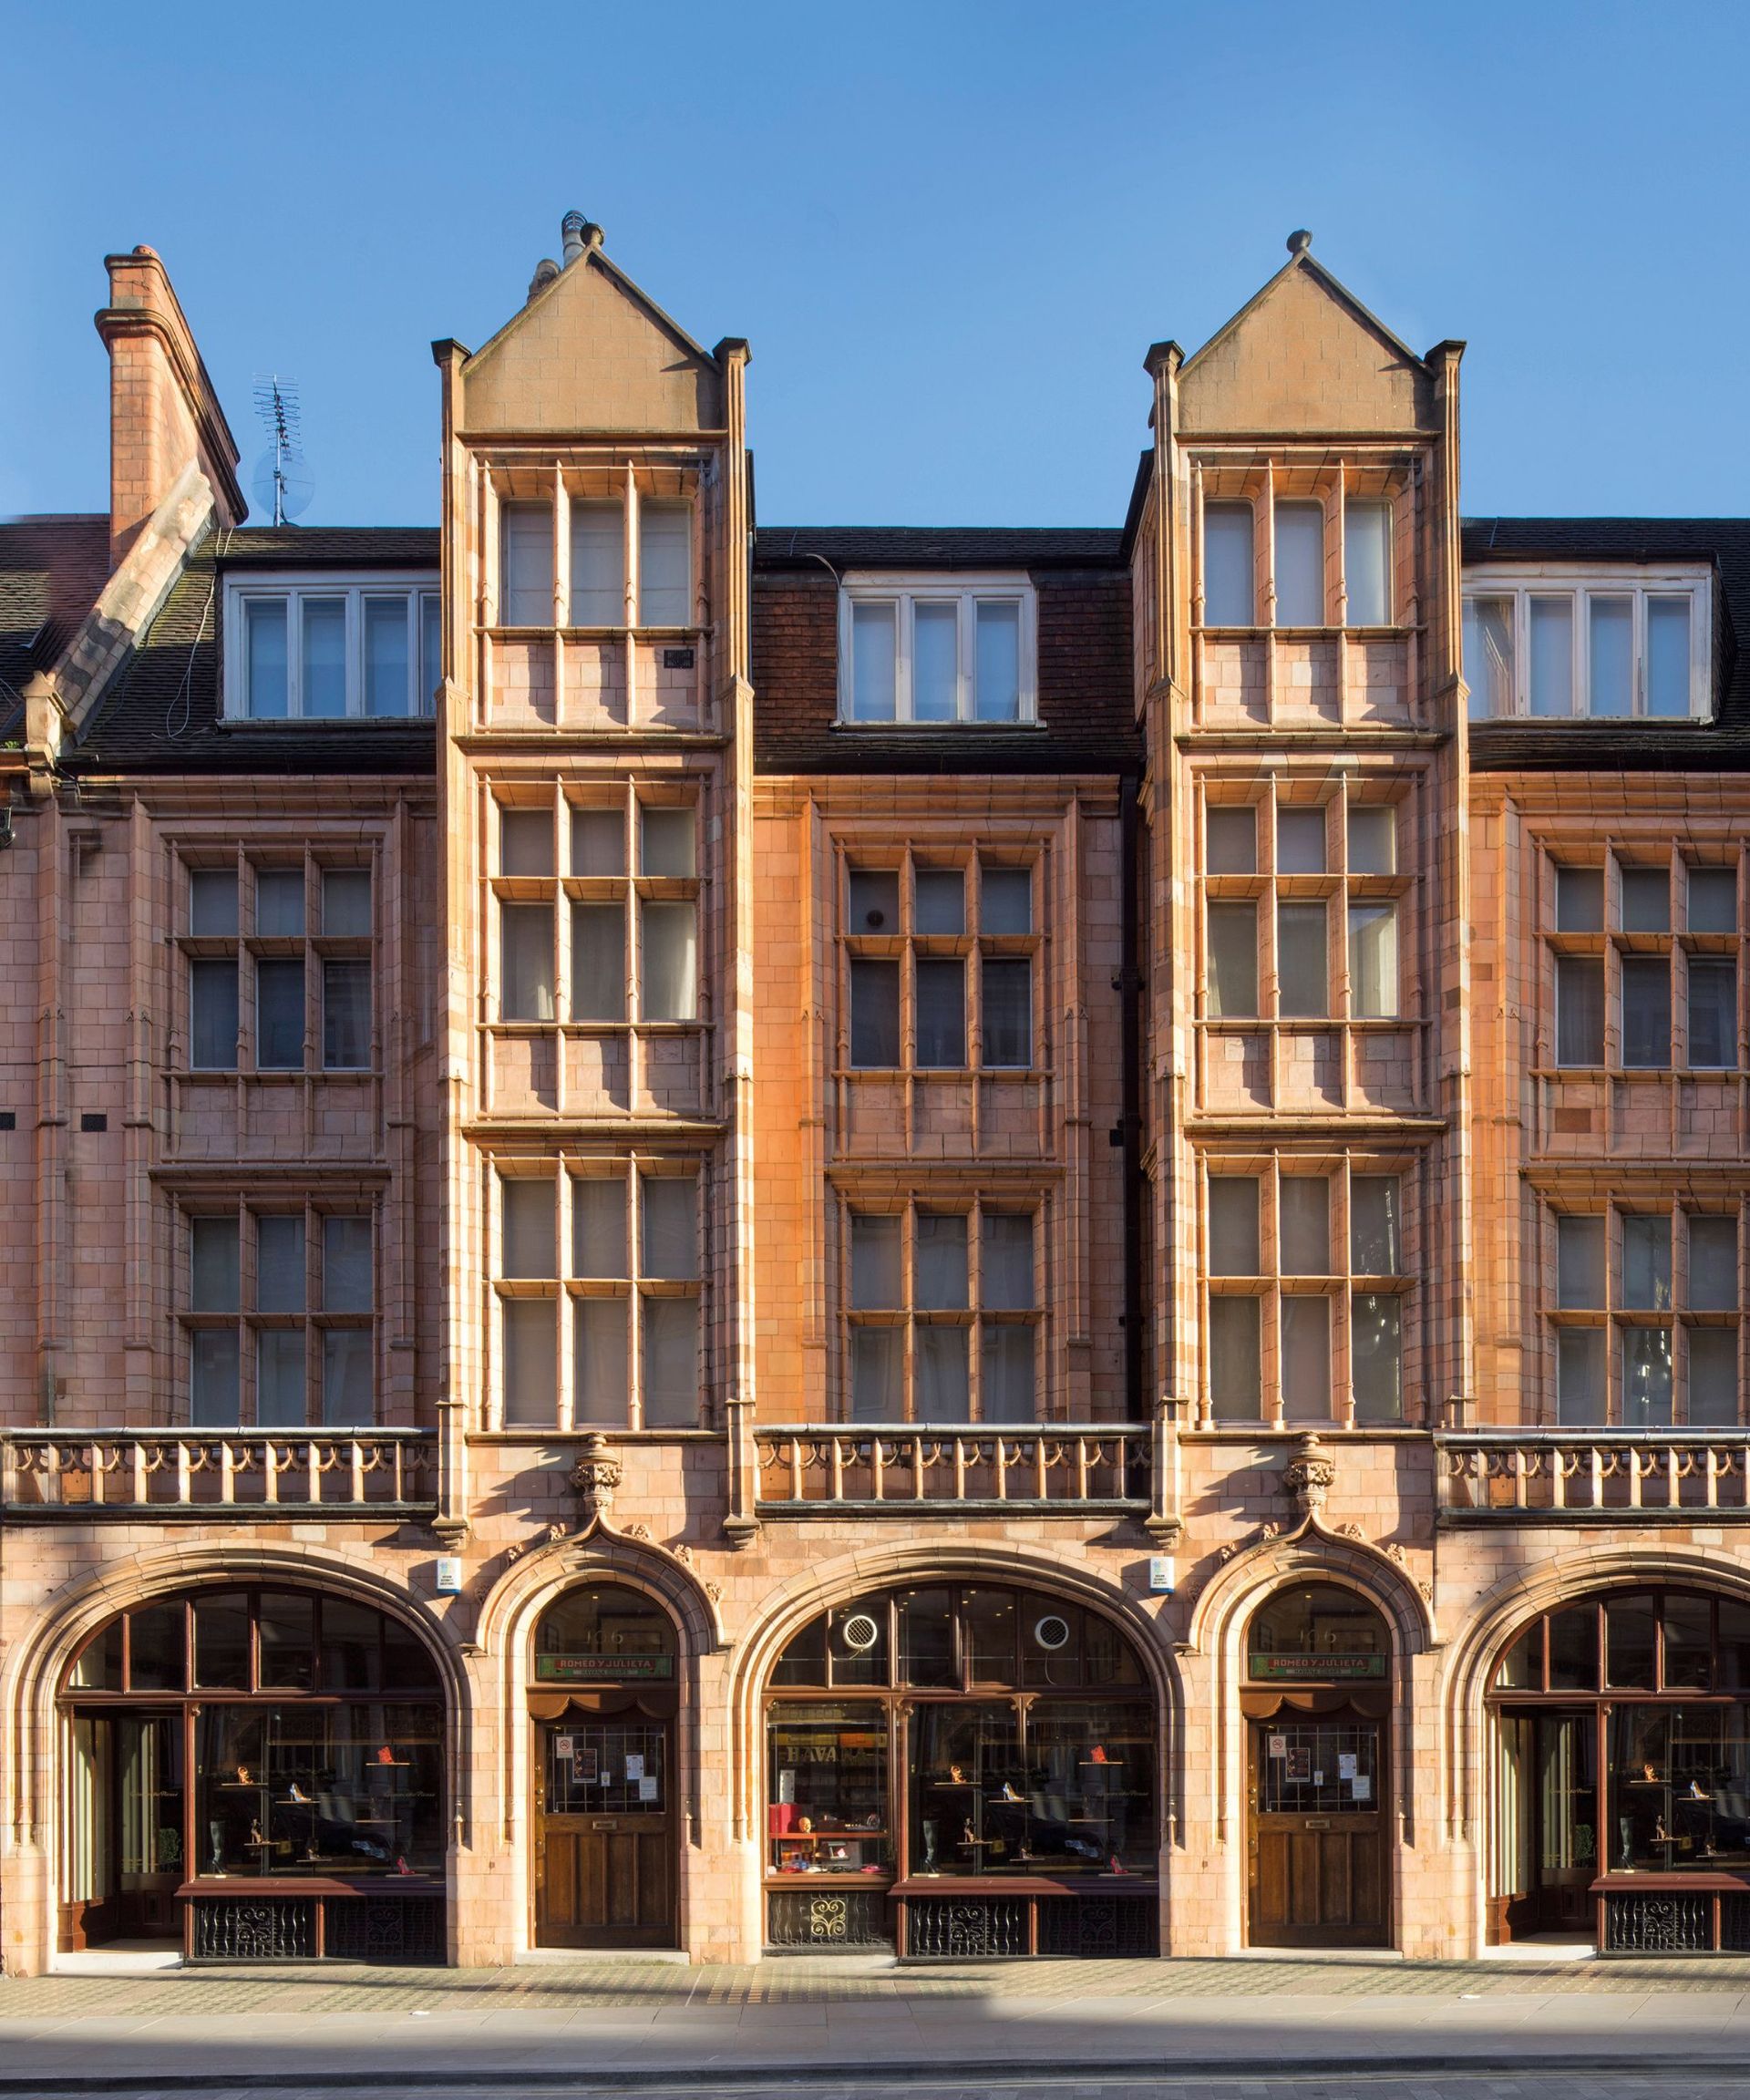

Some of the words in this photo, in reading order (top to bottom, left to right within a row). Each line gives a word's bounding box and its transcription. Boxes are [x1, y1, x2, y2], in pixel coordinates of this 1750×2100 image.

[586, 1630, 624, 1645] 106
[1300, 1628, 1337, 1644] 106
[560, 1659, 596, 1668] ROMEO
[597, 1659, 605, 1668] Y
[606, 1659, 652, 1668] JULIETA
[1273, 1658, 1309, 1667] ROMEO
[1310, 1658, 1318, 1667] Y
[1319, 1658, 1364, 1667] JULIETA
